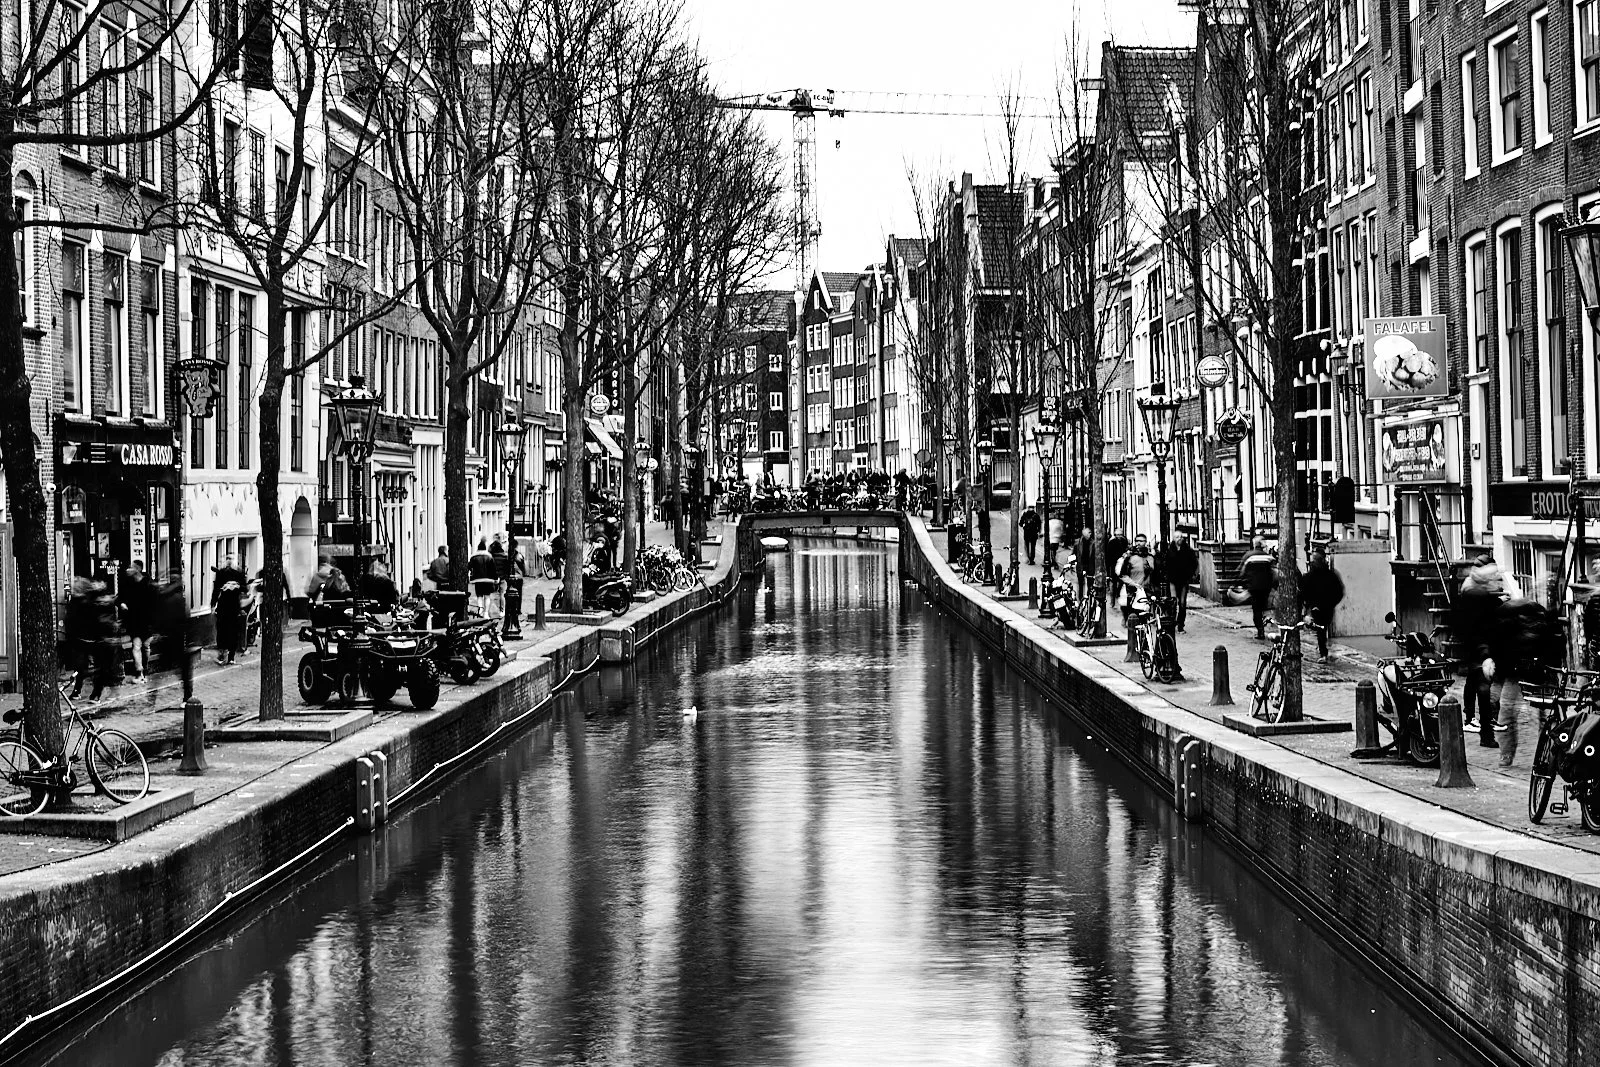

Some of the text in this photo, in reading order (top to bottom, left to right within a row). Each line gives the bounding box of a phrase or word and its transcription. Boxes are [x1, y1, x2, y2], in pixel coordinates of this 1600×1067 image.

[1374, 320, 1437, 335] FALAFEL
[121, 444, 173, 466] CASA ROSSO
[132, 517, 144, 557] TATT
